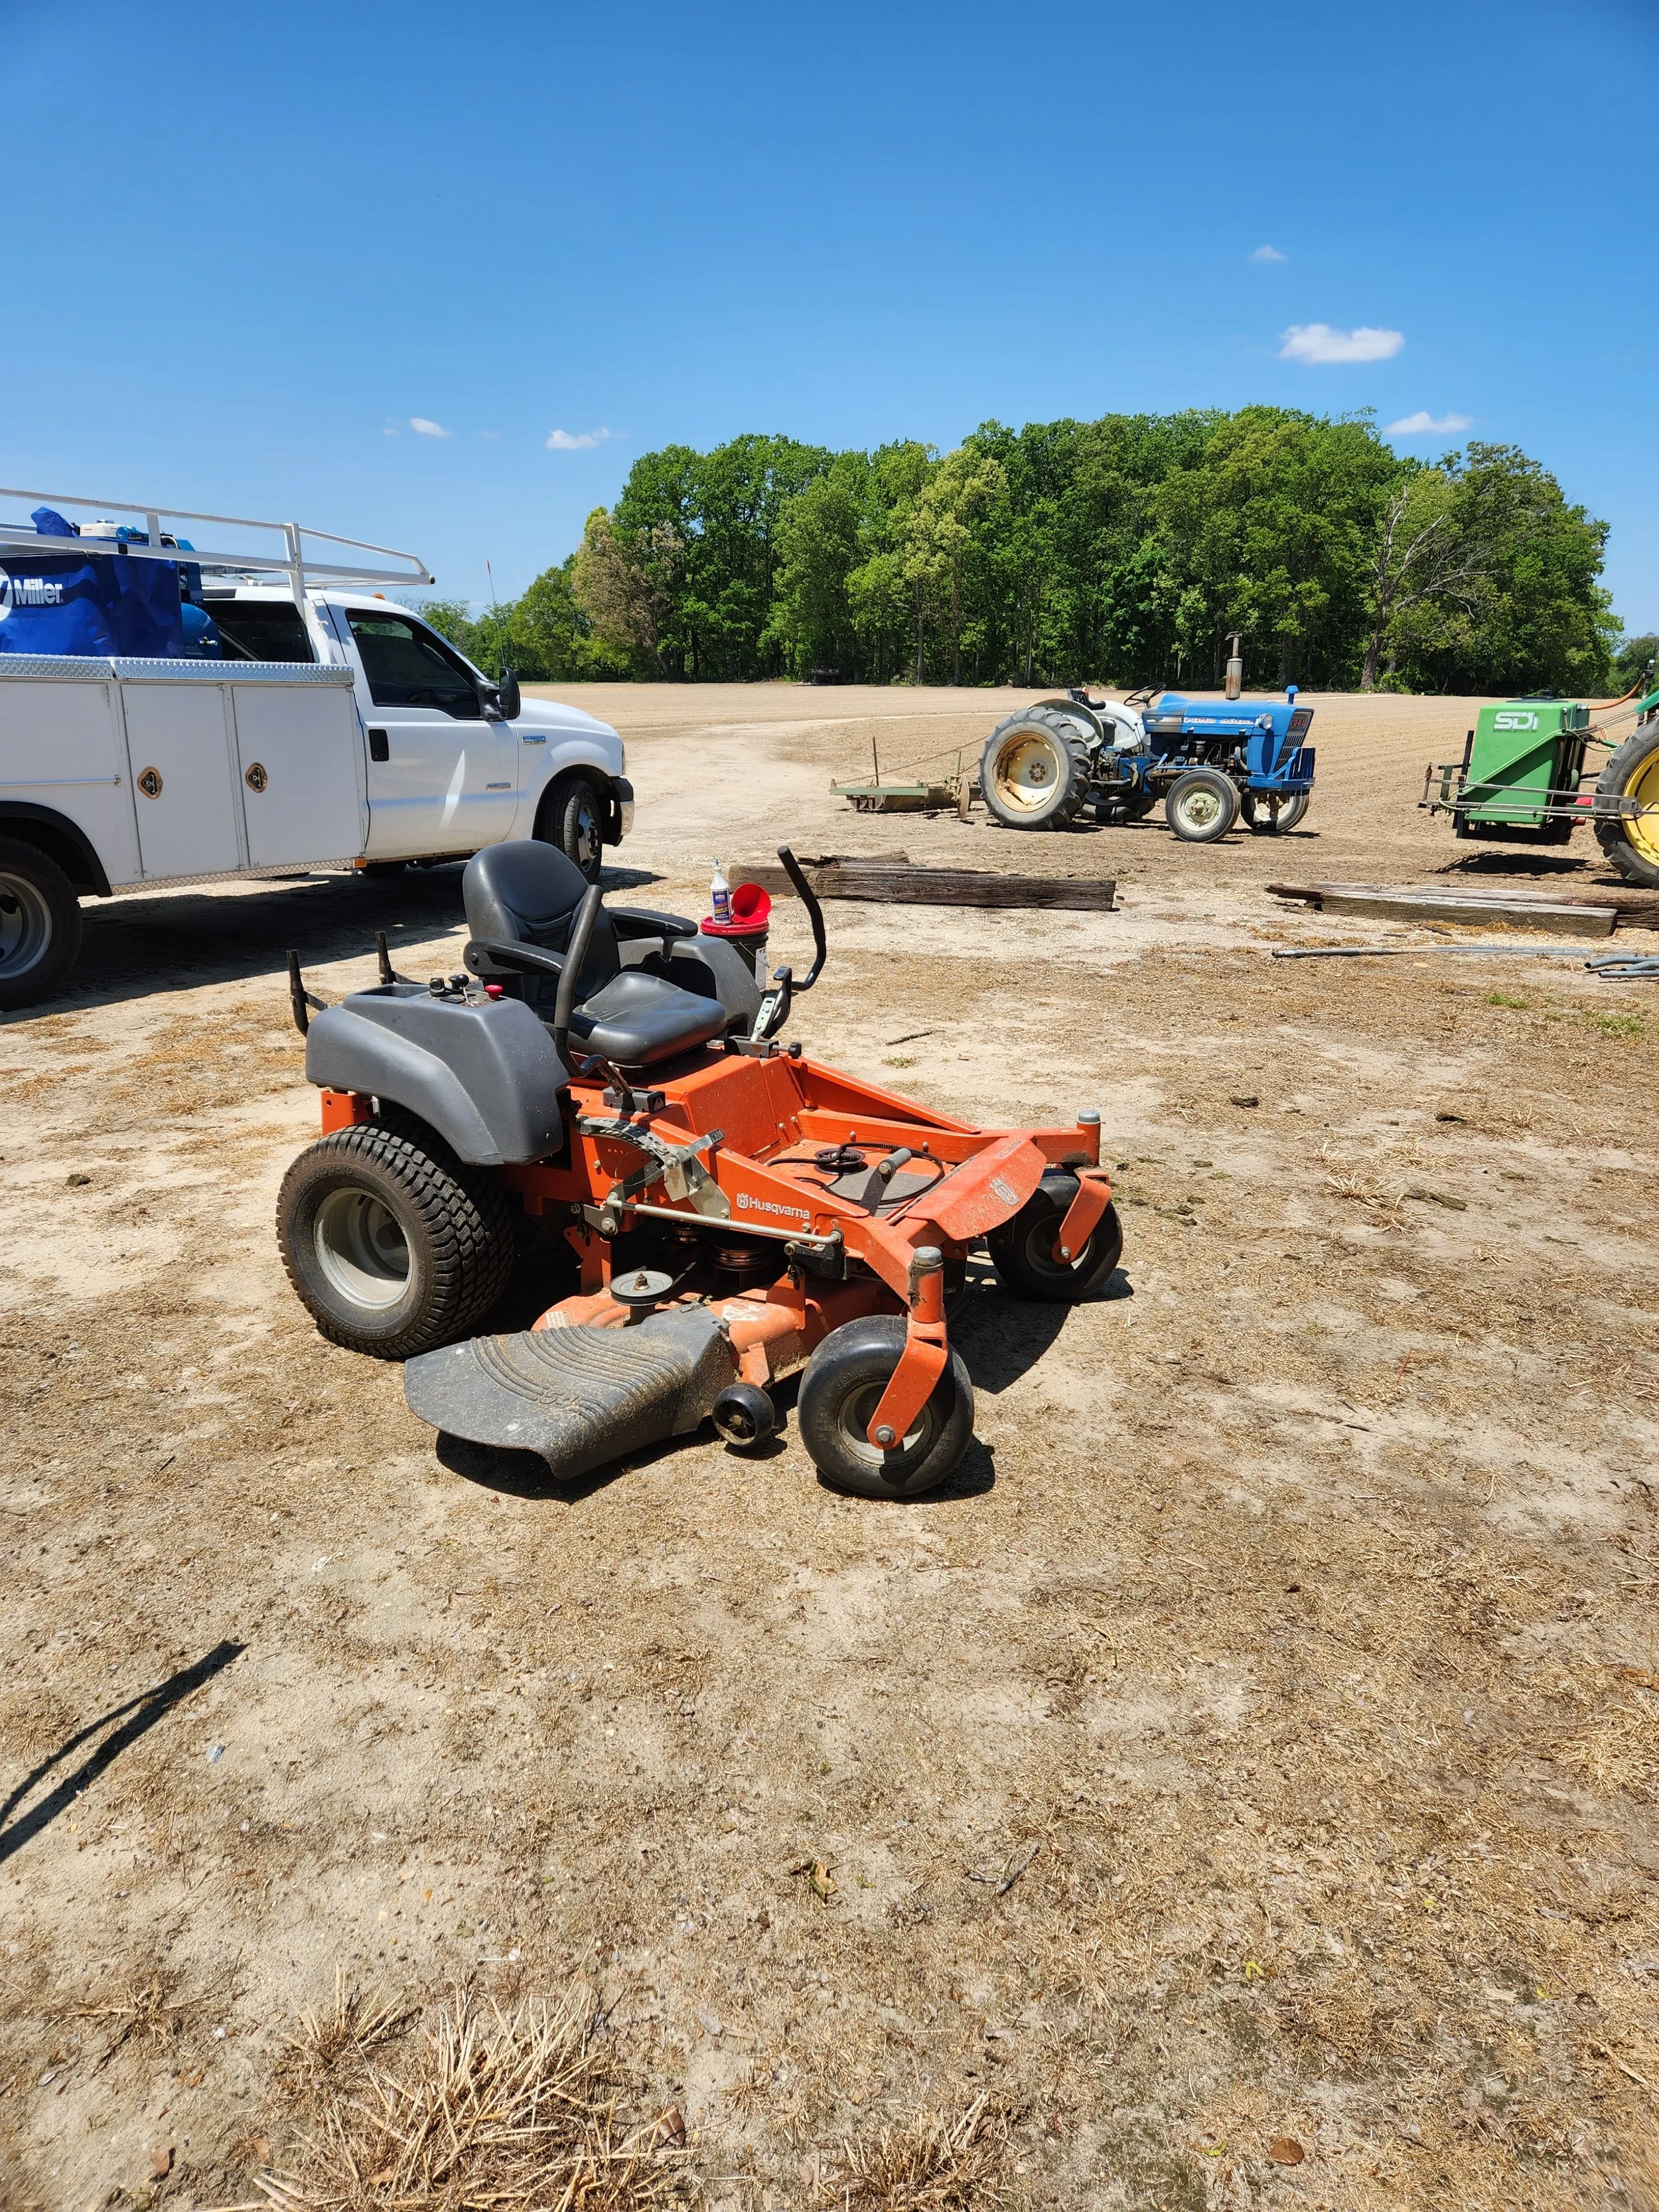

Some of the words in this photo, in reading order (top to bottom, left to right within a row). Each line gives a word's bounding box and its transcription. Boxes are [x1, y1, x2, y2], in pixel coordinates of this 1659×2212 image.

[14, 578, 63, 605] Miller
[1494, 711, 1539, 729] SDI
[749, 1197, 810, 1220] Husqvarna
